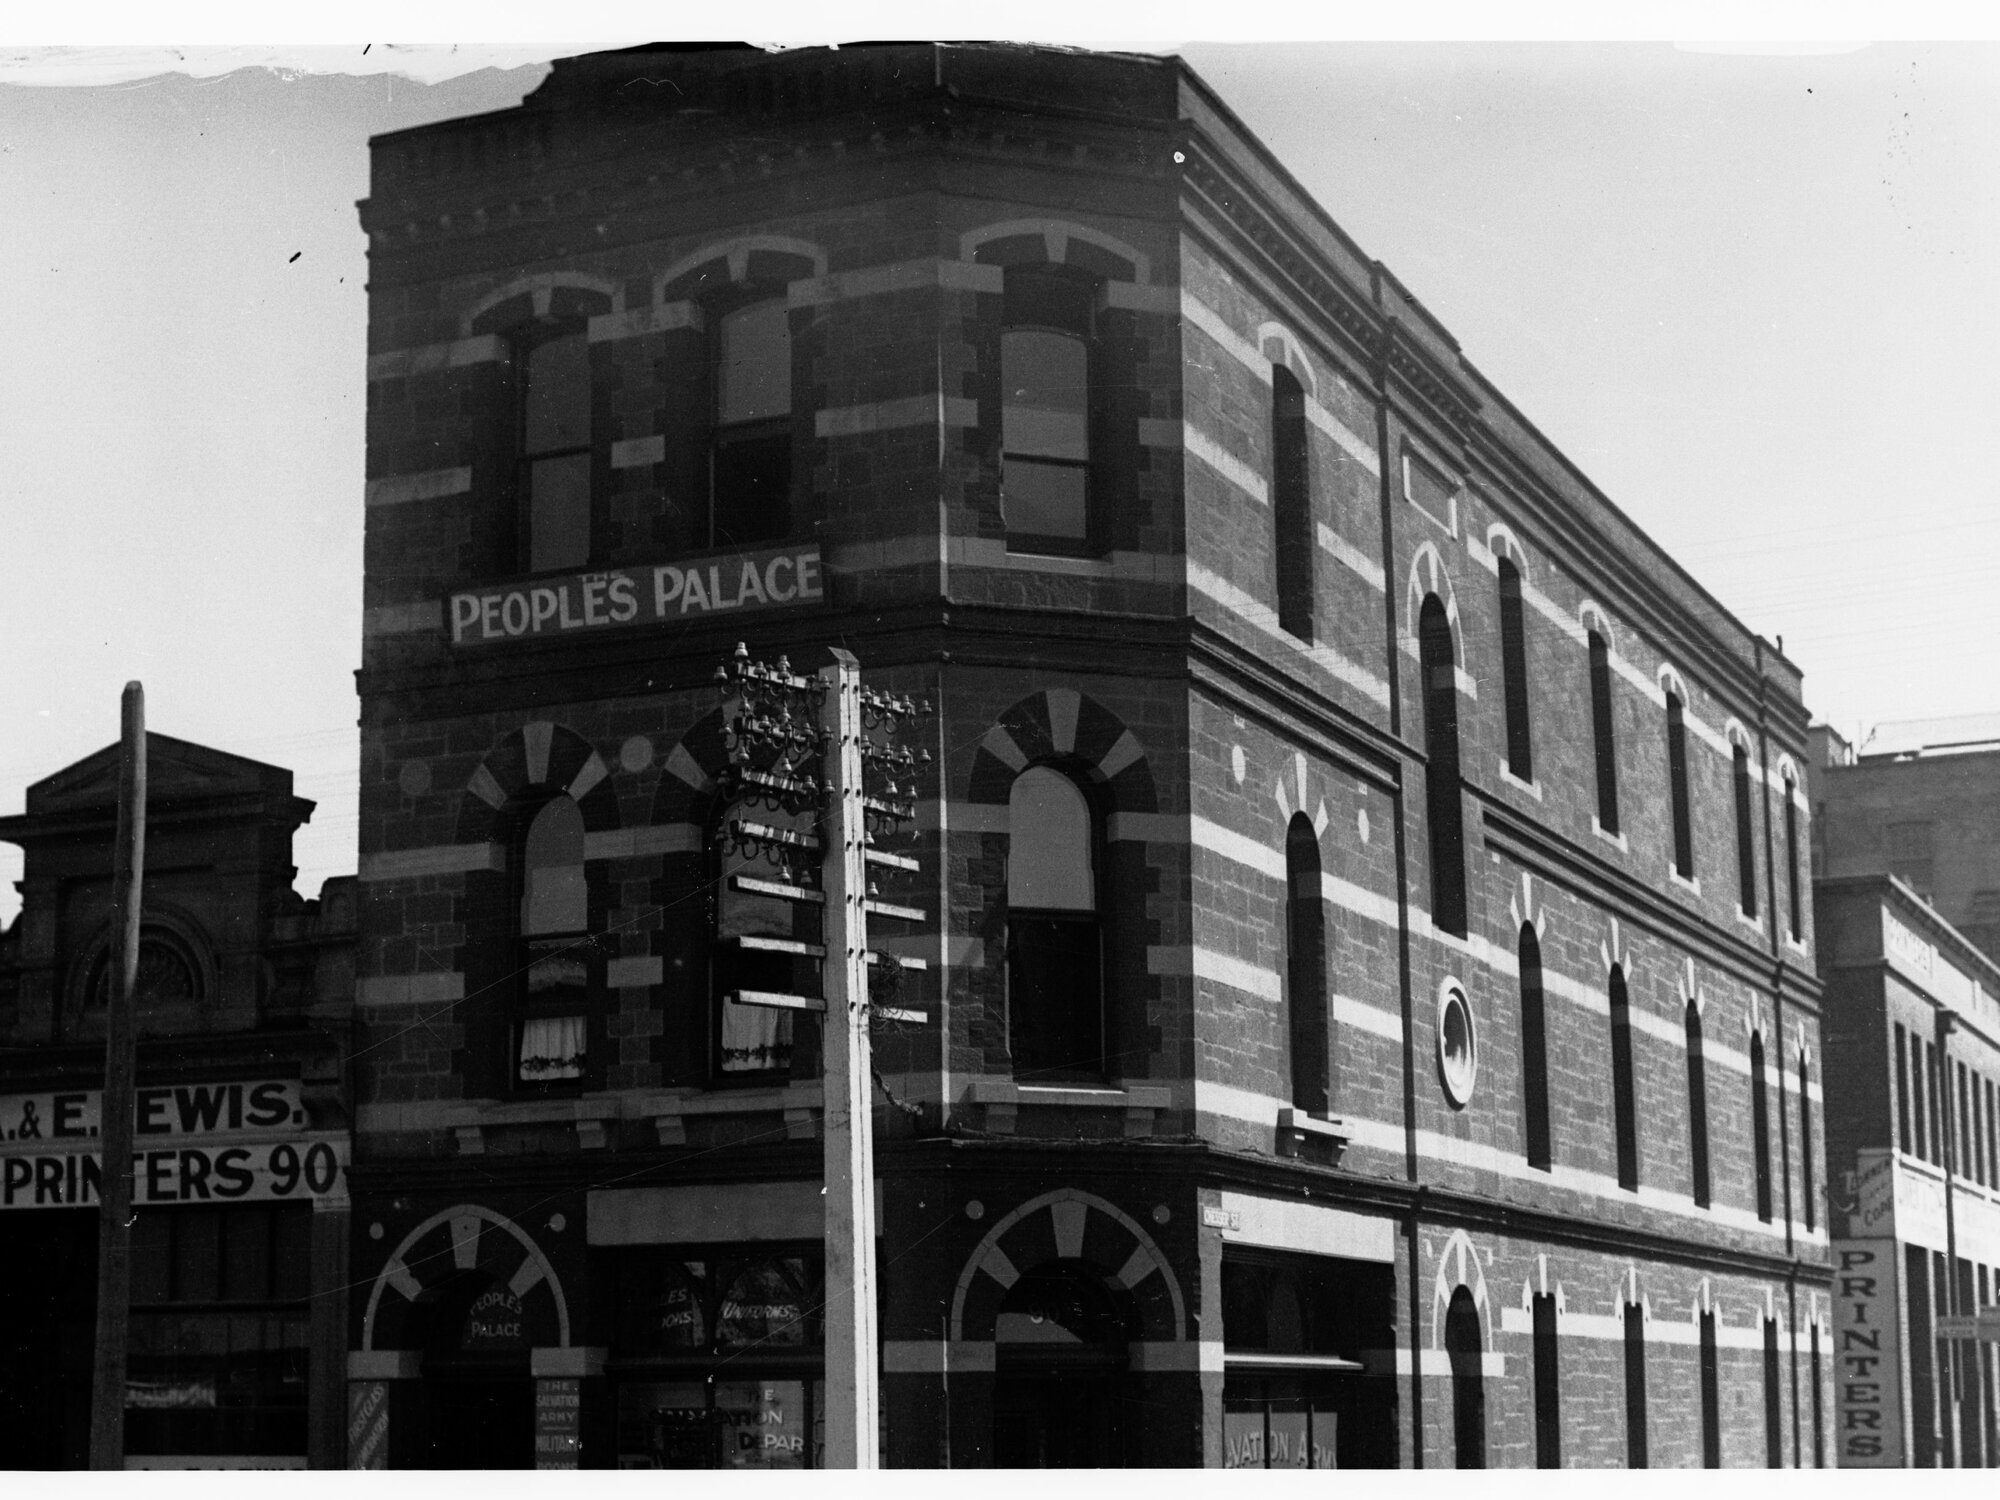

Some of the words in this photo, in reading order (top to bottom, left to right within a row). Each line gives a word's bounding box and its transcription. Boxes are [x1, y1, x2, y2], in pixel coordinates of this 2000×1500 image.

[653, 552, 824, 618] PALACE
[101, 1083, 303, 1138] EWIS.
[268, 1142, 337, 1196] 90
[470, 1322, 521, 1339] PALACE
[1838, 1251, 1883, 1459] PRINTERS
[539, 1411, 576, 1423] ARMY
